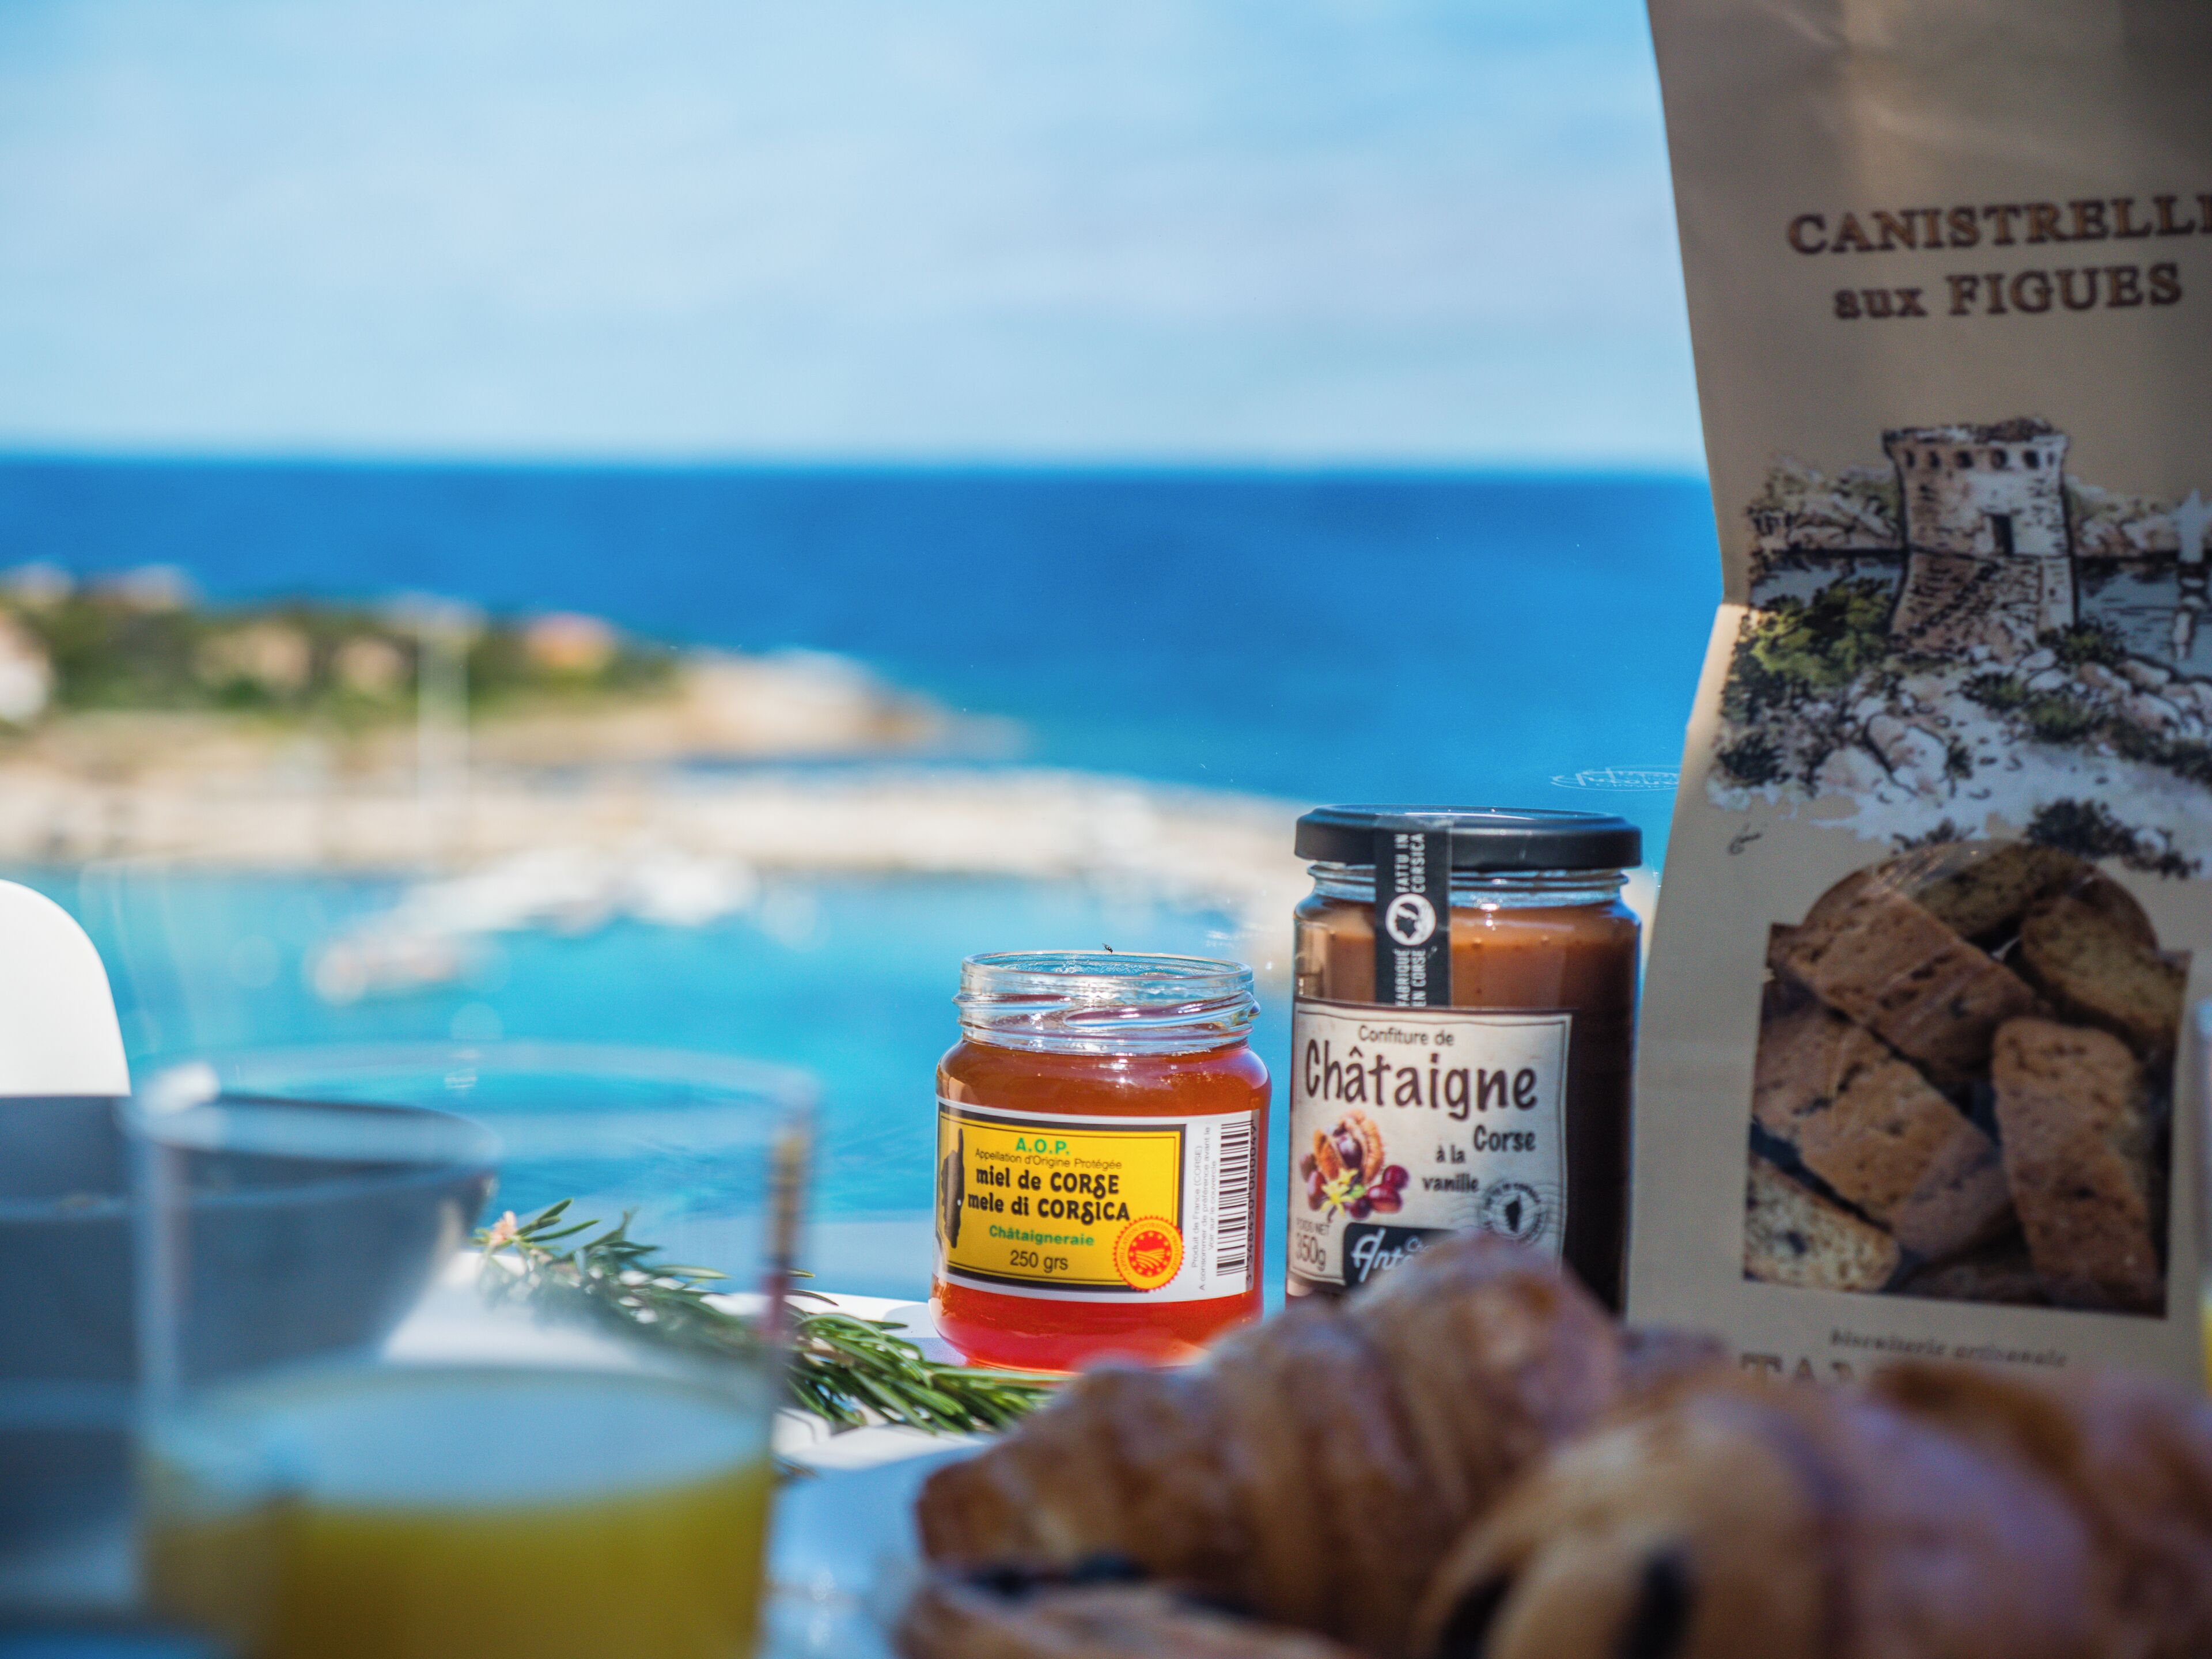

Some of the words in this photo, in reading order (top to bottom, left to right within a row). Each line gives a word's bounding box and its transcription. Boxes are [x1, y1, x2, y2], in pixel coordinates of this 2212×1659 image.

[1834, 289, 1927, 319] aux
[1945, 262, 2183, 316] FIGUES
[1395, 834, 1409, 849] IN
[1395, 854, 1410, 892] FATTU
[1410, 834, 1426, 893] CORSICA
[1393, 949, 1410, 1007] FABRIQUÉ
[1411, 949, 1426, 987] CORSE
[1411, 991, 1426, 1007] EN
[1359, 1025, 1428, 1045] Confiture
[1434, 1029, 1455, 1046] de
[1305, 1038, 1537, 1121] Châtaigne
[1205, 1127, 1211, 1135] le
[1474, 1124, 1536, 1152] Corse
[1016, 1137, 1070, 1155] A.O.P.
[1436, 1145, 1446, 1163] à
[1450, 1145, 1465, 1164] la
[975, 1148, 1022, 1165] Appellation
[1024, 1155, 1070, 1169] d'Origine
[1074, 1158, 1122, 1171] Protégée
[1194, 1146, 1202, 1186] (CORSE)
[976, 1165, 1010, 1188] miel
[1018, 1169, 1041, 1191] de
[1050, 1172, 1119, 1200] CORSE
[1202, 1164, 1210, 1213] préférence
[1422, 1173, 1479, 1192] vanille
[968, 1192, 1004, 1213] mele
[1011, 1196, 1029, 1216] di
[1037, 1198, 1130, 1225] CORSICA
[1193, 1189, 1201, 1219] France
[1210, 1206, 1215, 1215] le
[1194, 1222, 1200, 1230] de
[1202, 1215, 1208, 1226] de
[989, 1225, 1094, 1245] Châtaigneraie
[1010, 1249, 1039, 1268] 250
[1043, 1256, 1069, 1274] grs
